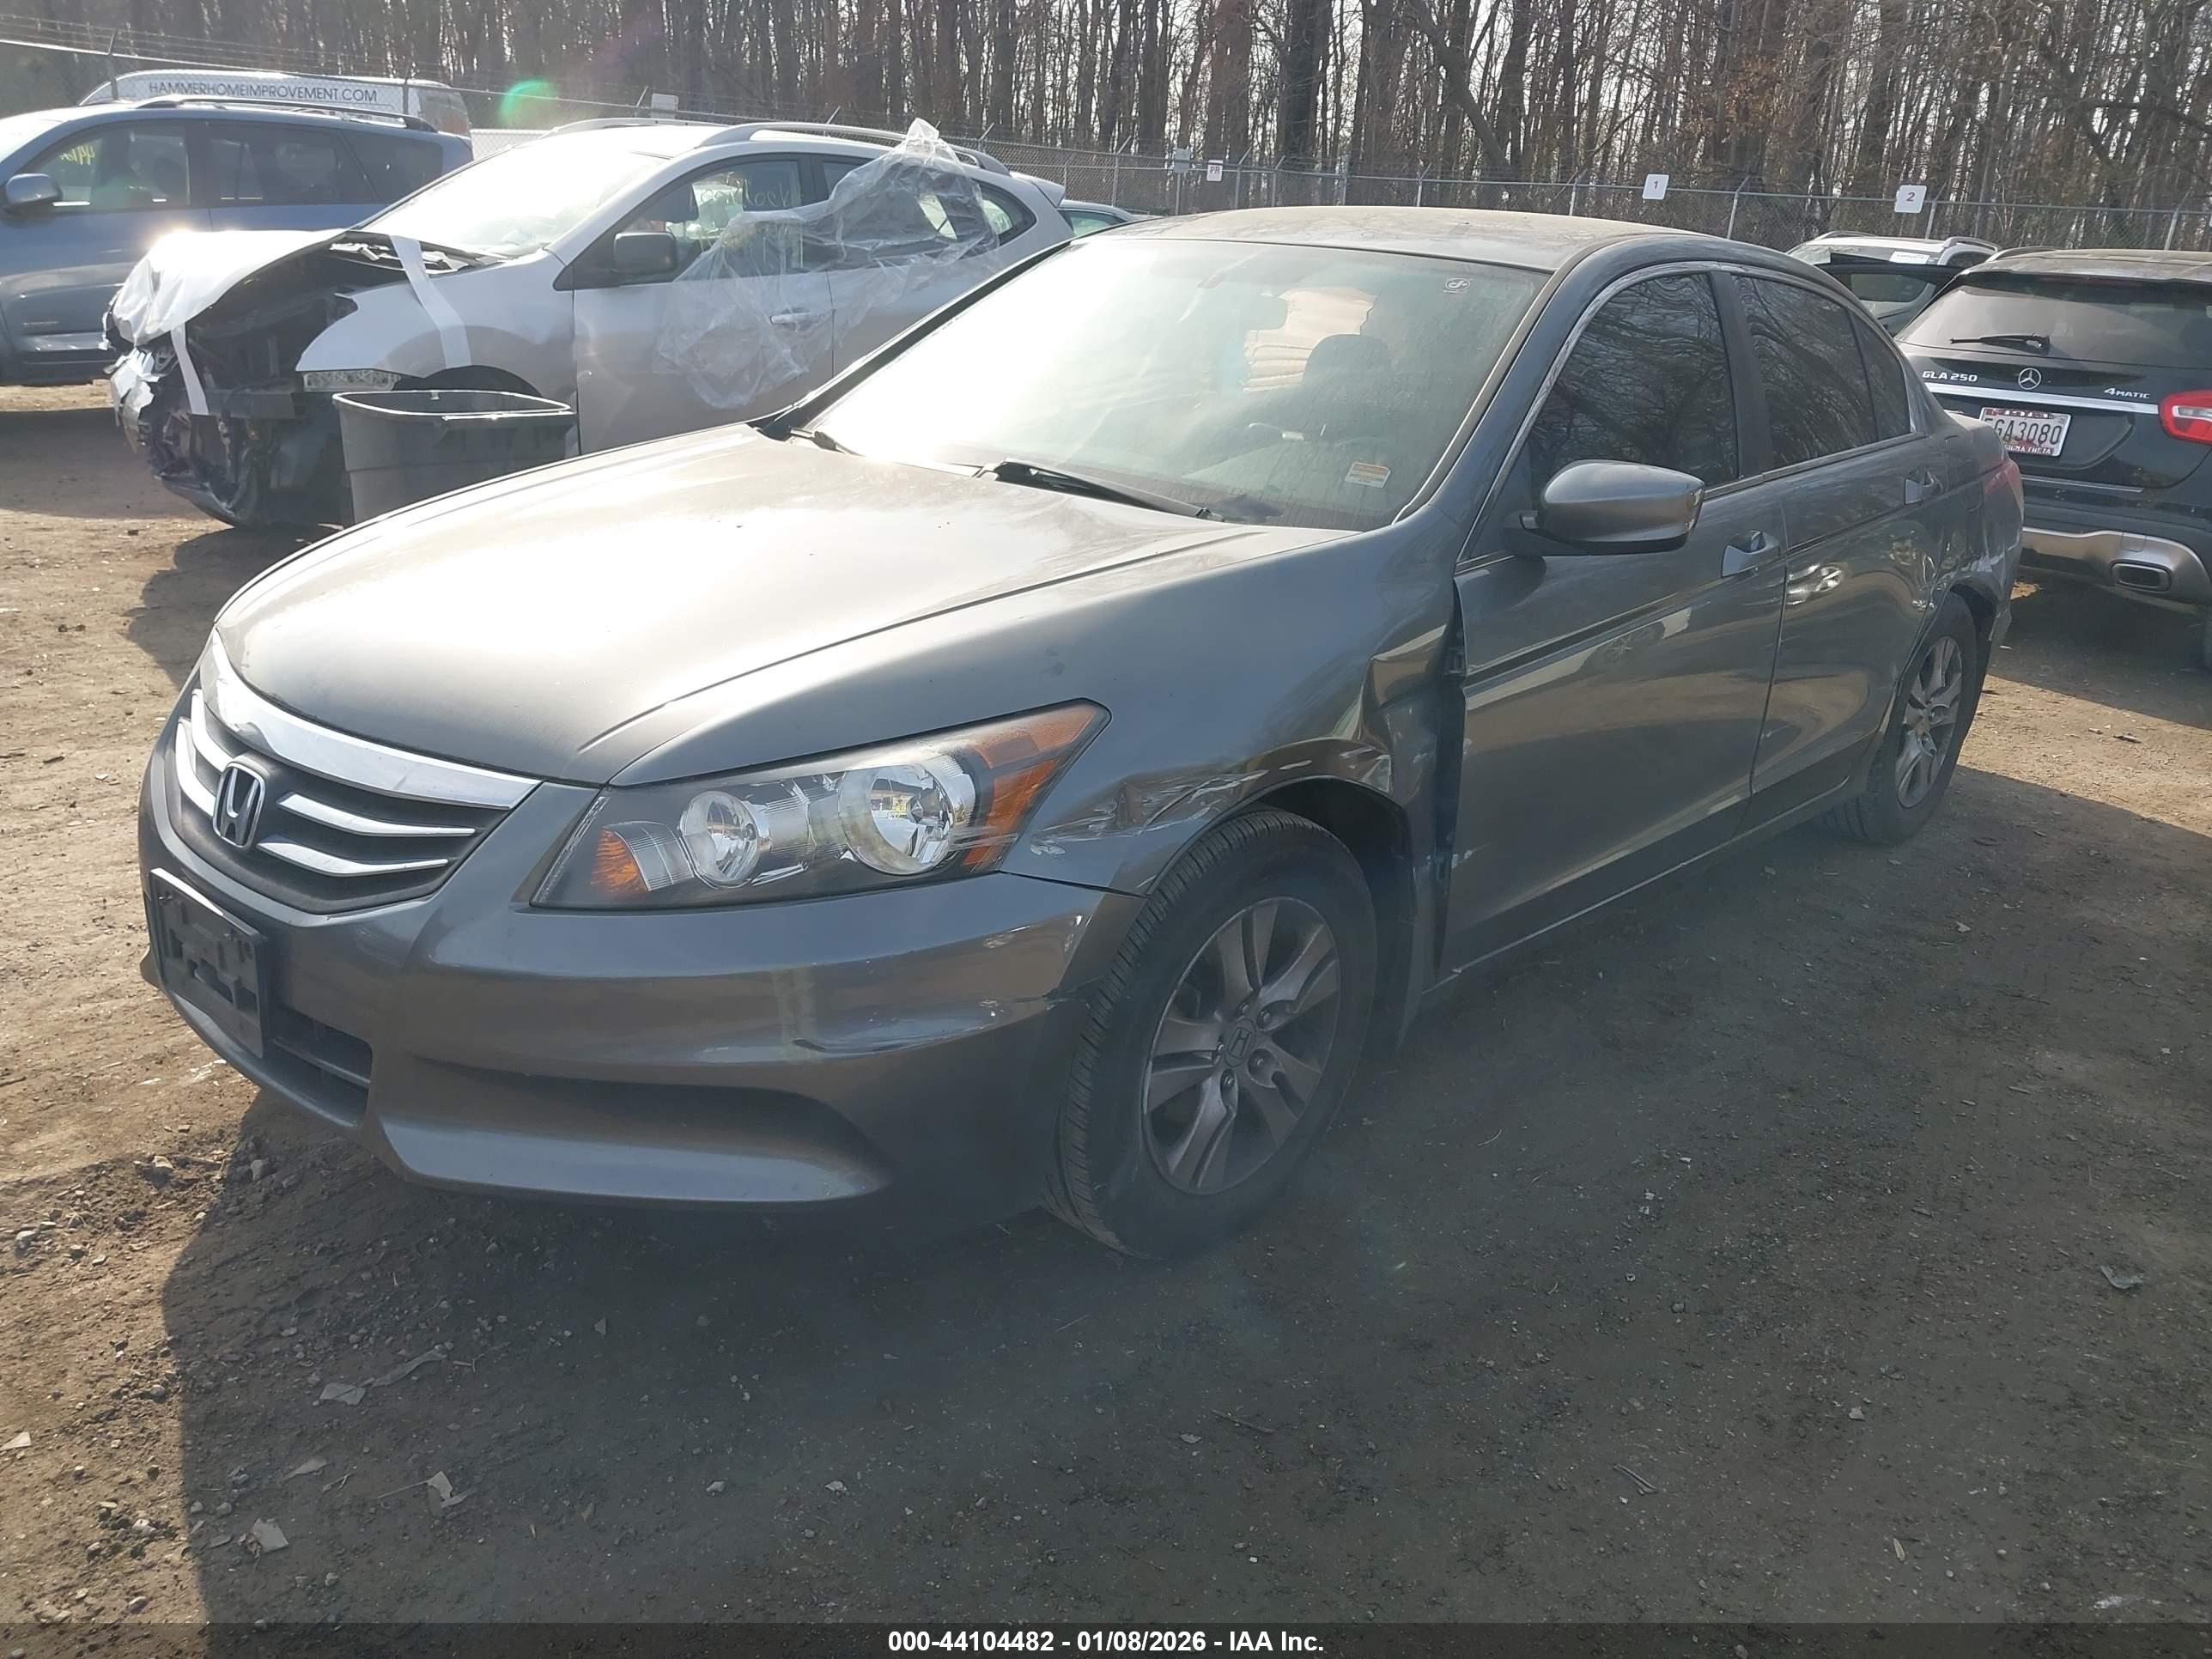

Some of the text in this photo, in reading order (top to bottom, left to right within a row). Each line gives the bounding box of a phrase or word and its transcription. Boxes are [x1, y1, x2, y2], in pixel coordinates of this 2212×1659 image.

[1906, 191, 1916, 202] 2
[1923, 370, 1978, 382] GLA 250
[2104, 387, 2151, 399] 4MATIC
[1985, 417, 2063, 445] GA3080
